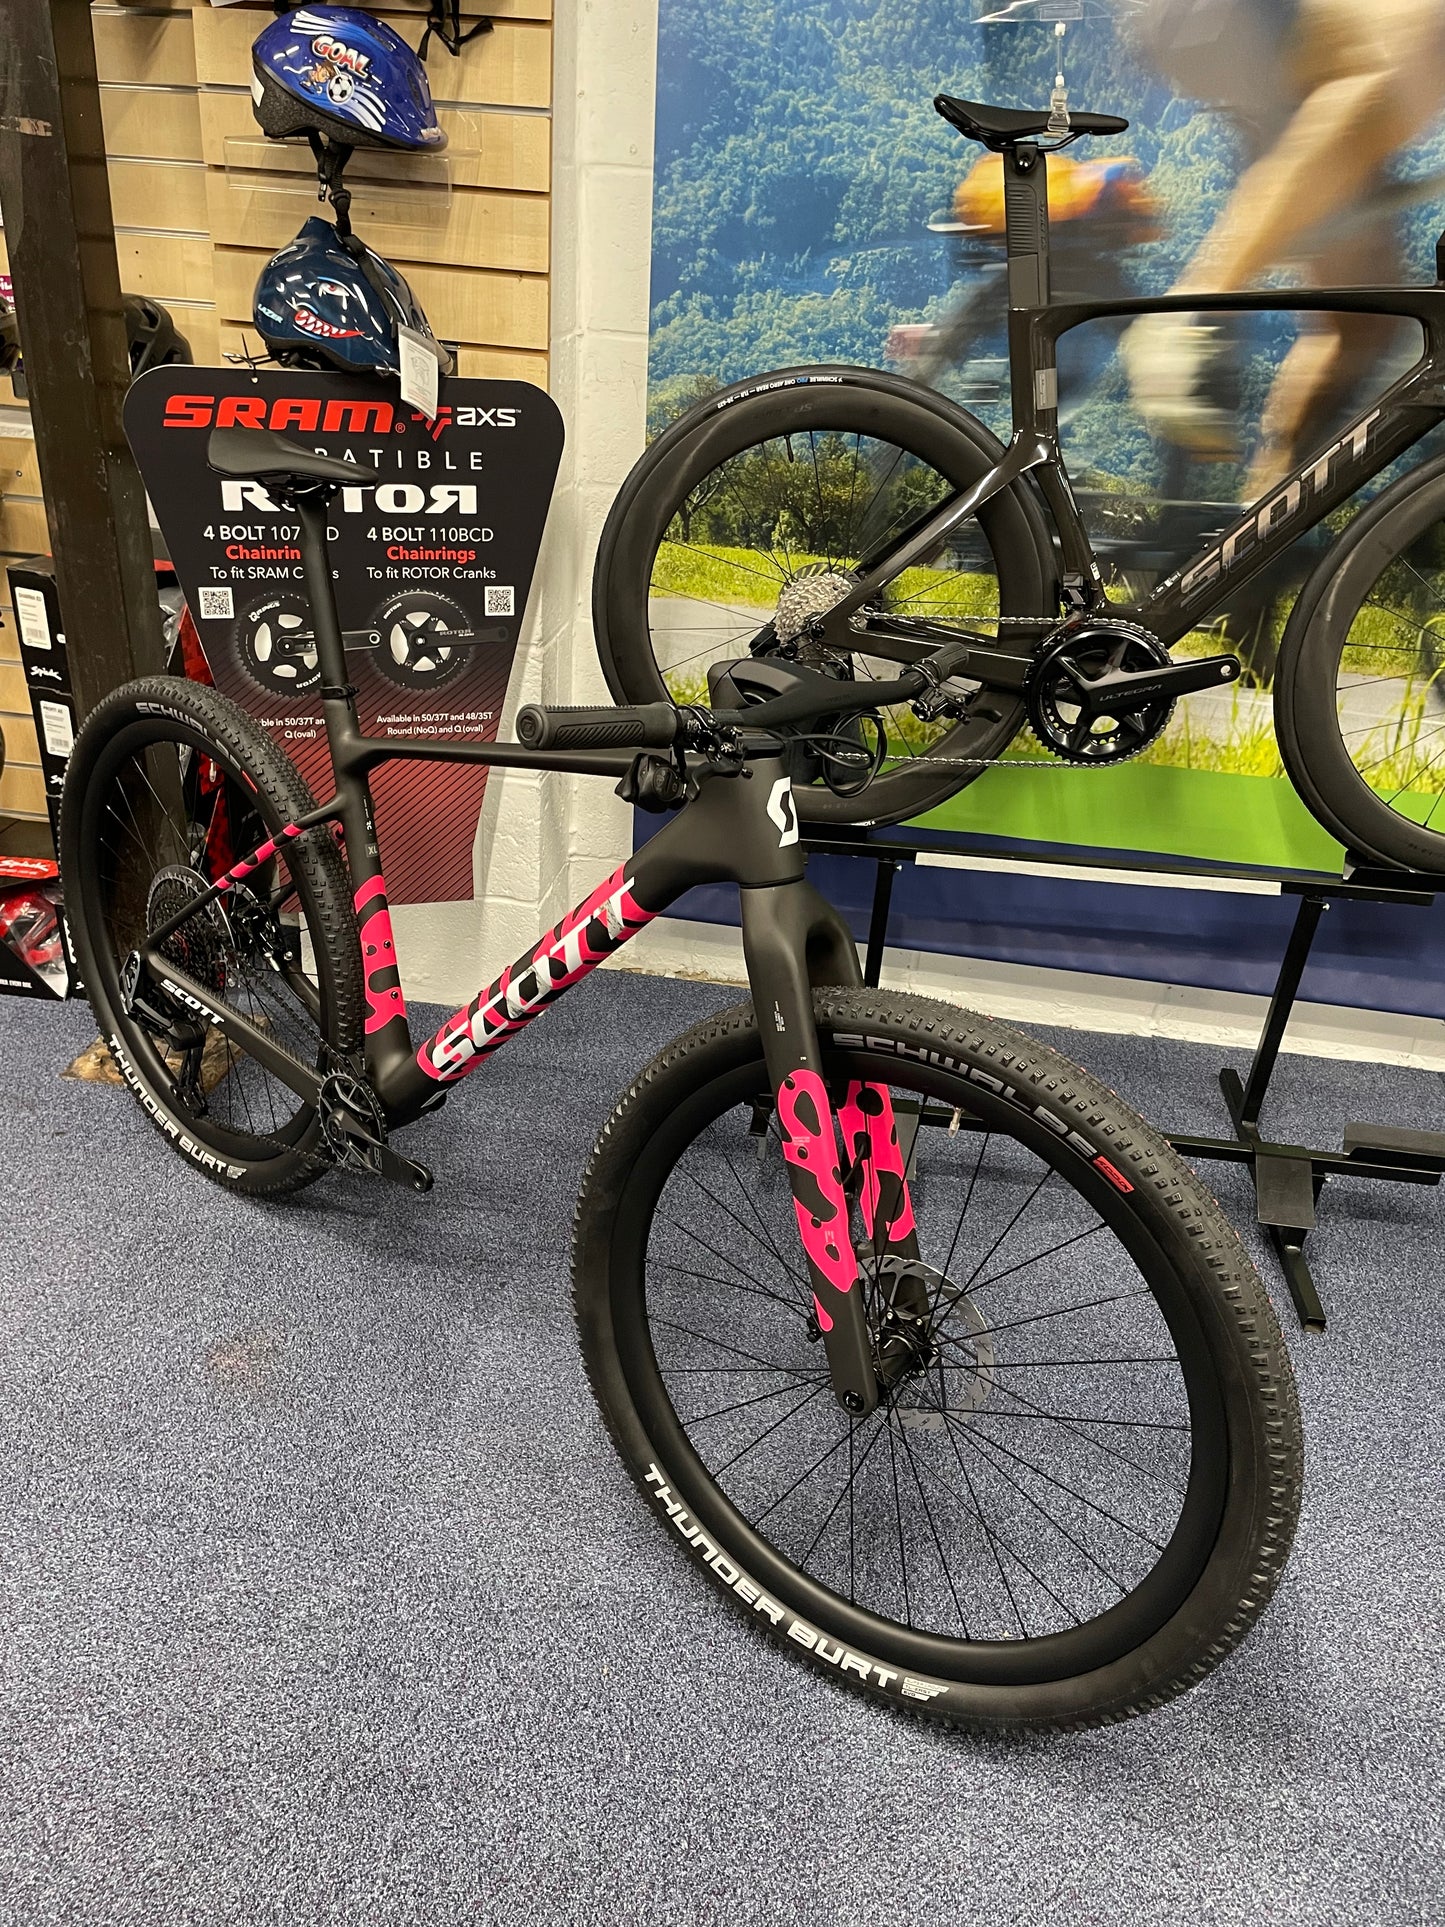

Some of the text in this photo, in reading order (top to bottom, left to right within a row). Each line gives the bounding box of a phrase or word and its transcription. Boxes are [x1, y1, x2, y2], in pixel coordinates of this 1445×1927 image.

[312, 35, 372, 80] GOAL
[784, 378, 796, 386] ONE
[163, 394, 394, 434] SRAM
[1180, 408, 1381, 609] SCOTT
[203, 525, 340, 541] 4 BOLT 107D
[366, 527, 494, 542] 4 BOLT 110BCD
[225, 544, 301, 560] Chainrin
[386, 545, 476, 564] Chainrings
[209, 566, 228, 579] To
[230, 566, 245, 579] fit
[248, 566, 289, 579] SRAM
[366, 566, 497, 579] To fit ROTOR Cranks
[439, 628, 472, 636] ROTOR
[1100, 684, 1163, 702] ULTEGRA
[285, 717, 314, 726] 50/37T
[376, 714, 412, 723] Available
[421, 713, 449, 722] 50/37T
[450, 713, 464, 721] and
[465, 712, 493, 720] 48/35T
[136, 702, 241, 770] SCHWAL
[284, 729, 317, 738] Q (oval)
[387, 724, 484, 735] Round (NoQ) and Q (oval)
[368, 845, 378, 855] XL
[432, 876, 635, 1081] SCOTT
[160, 978, 225, 1025] SCOTT
[108, 1033, 227, 1174] THUNDER BURT
[832, 1033, 1098, 1158] SCHWALBE
[643, 1462, 899, 1688] THUNDER BURT
